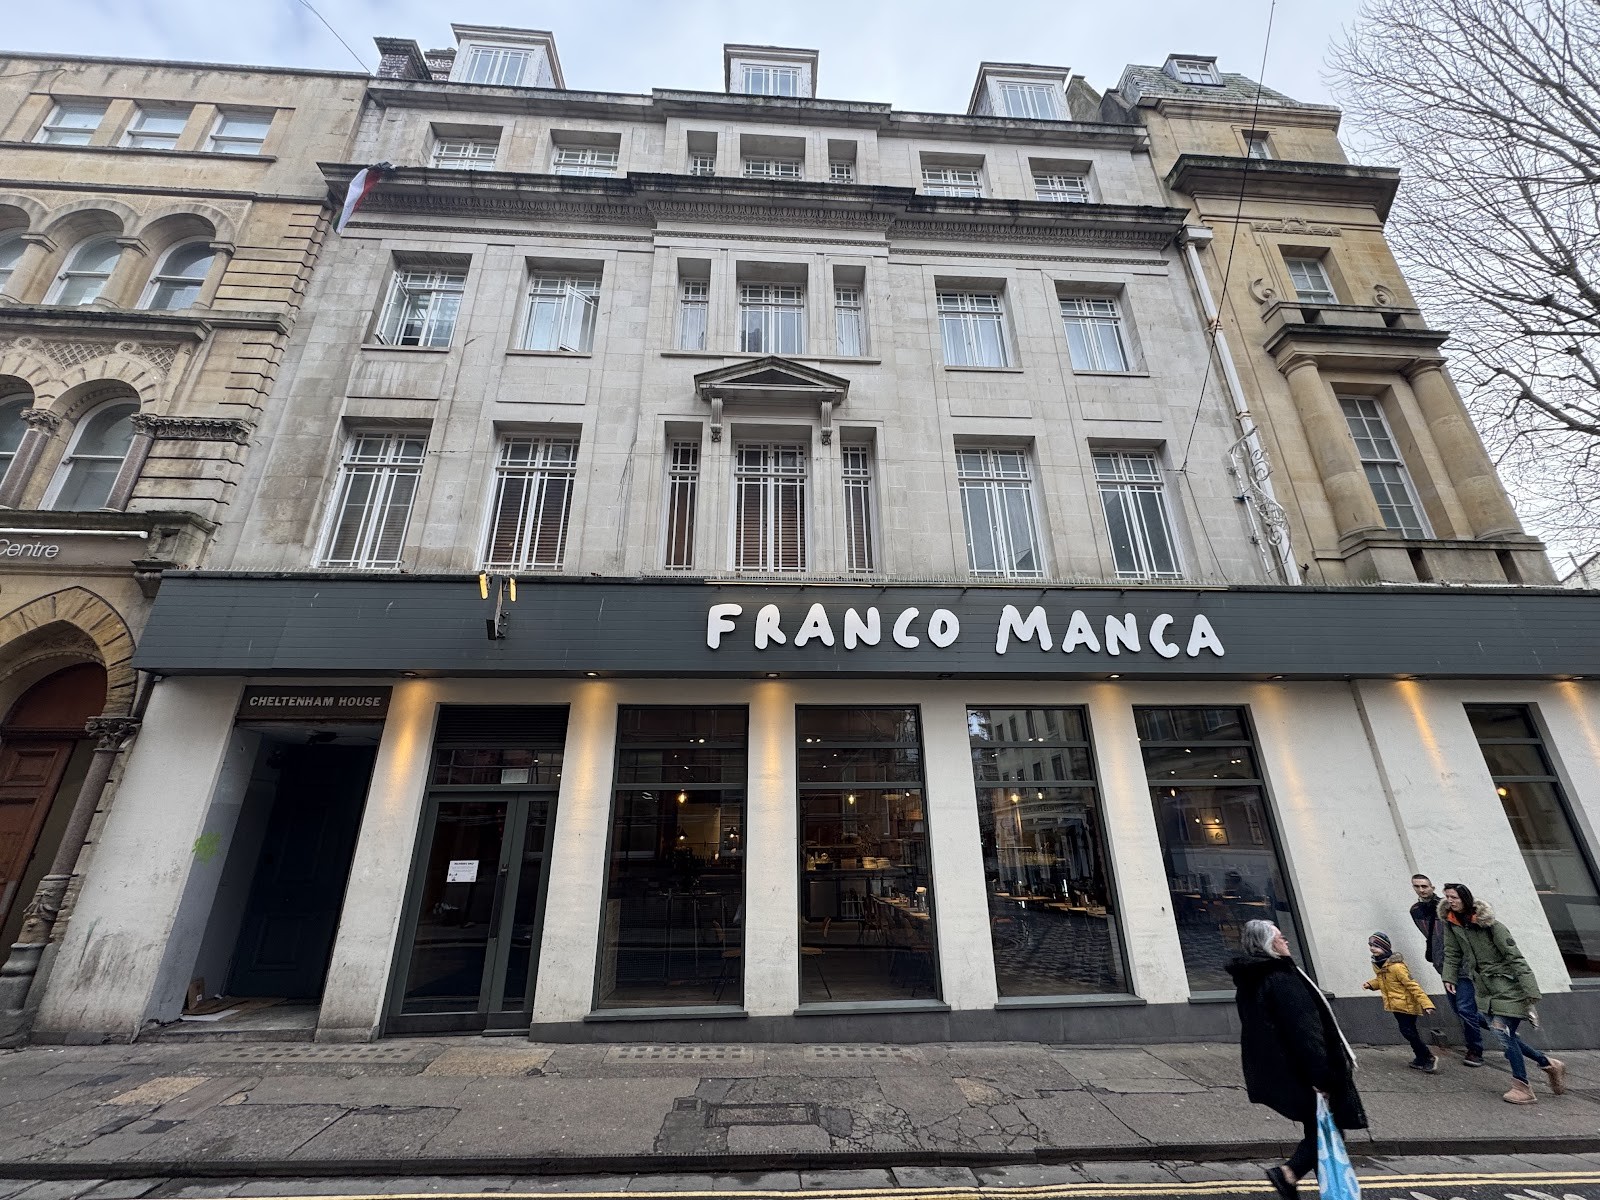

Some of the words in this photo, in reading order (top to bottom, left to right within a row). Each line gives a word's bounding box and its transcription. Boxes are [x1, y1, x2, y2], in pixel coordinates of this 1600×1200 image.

[708, 603, 960, 649] FRANCO
[996, 604, 1225, 658] MANCA
[249, 696, 333, 707] CHELTENHAM
[338, 697, 381, 707] HOUSE
